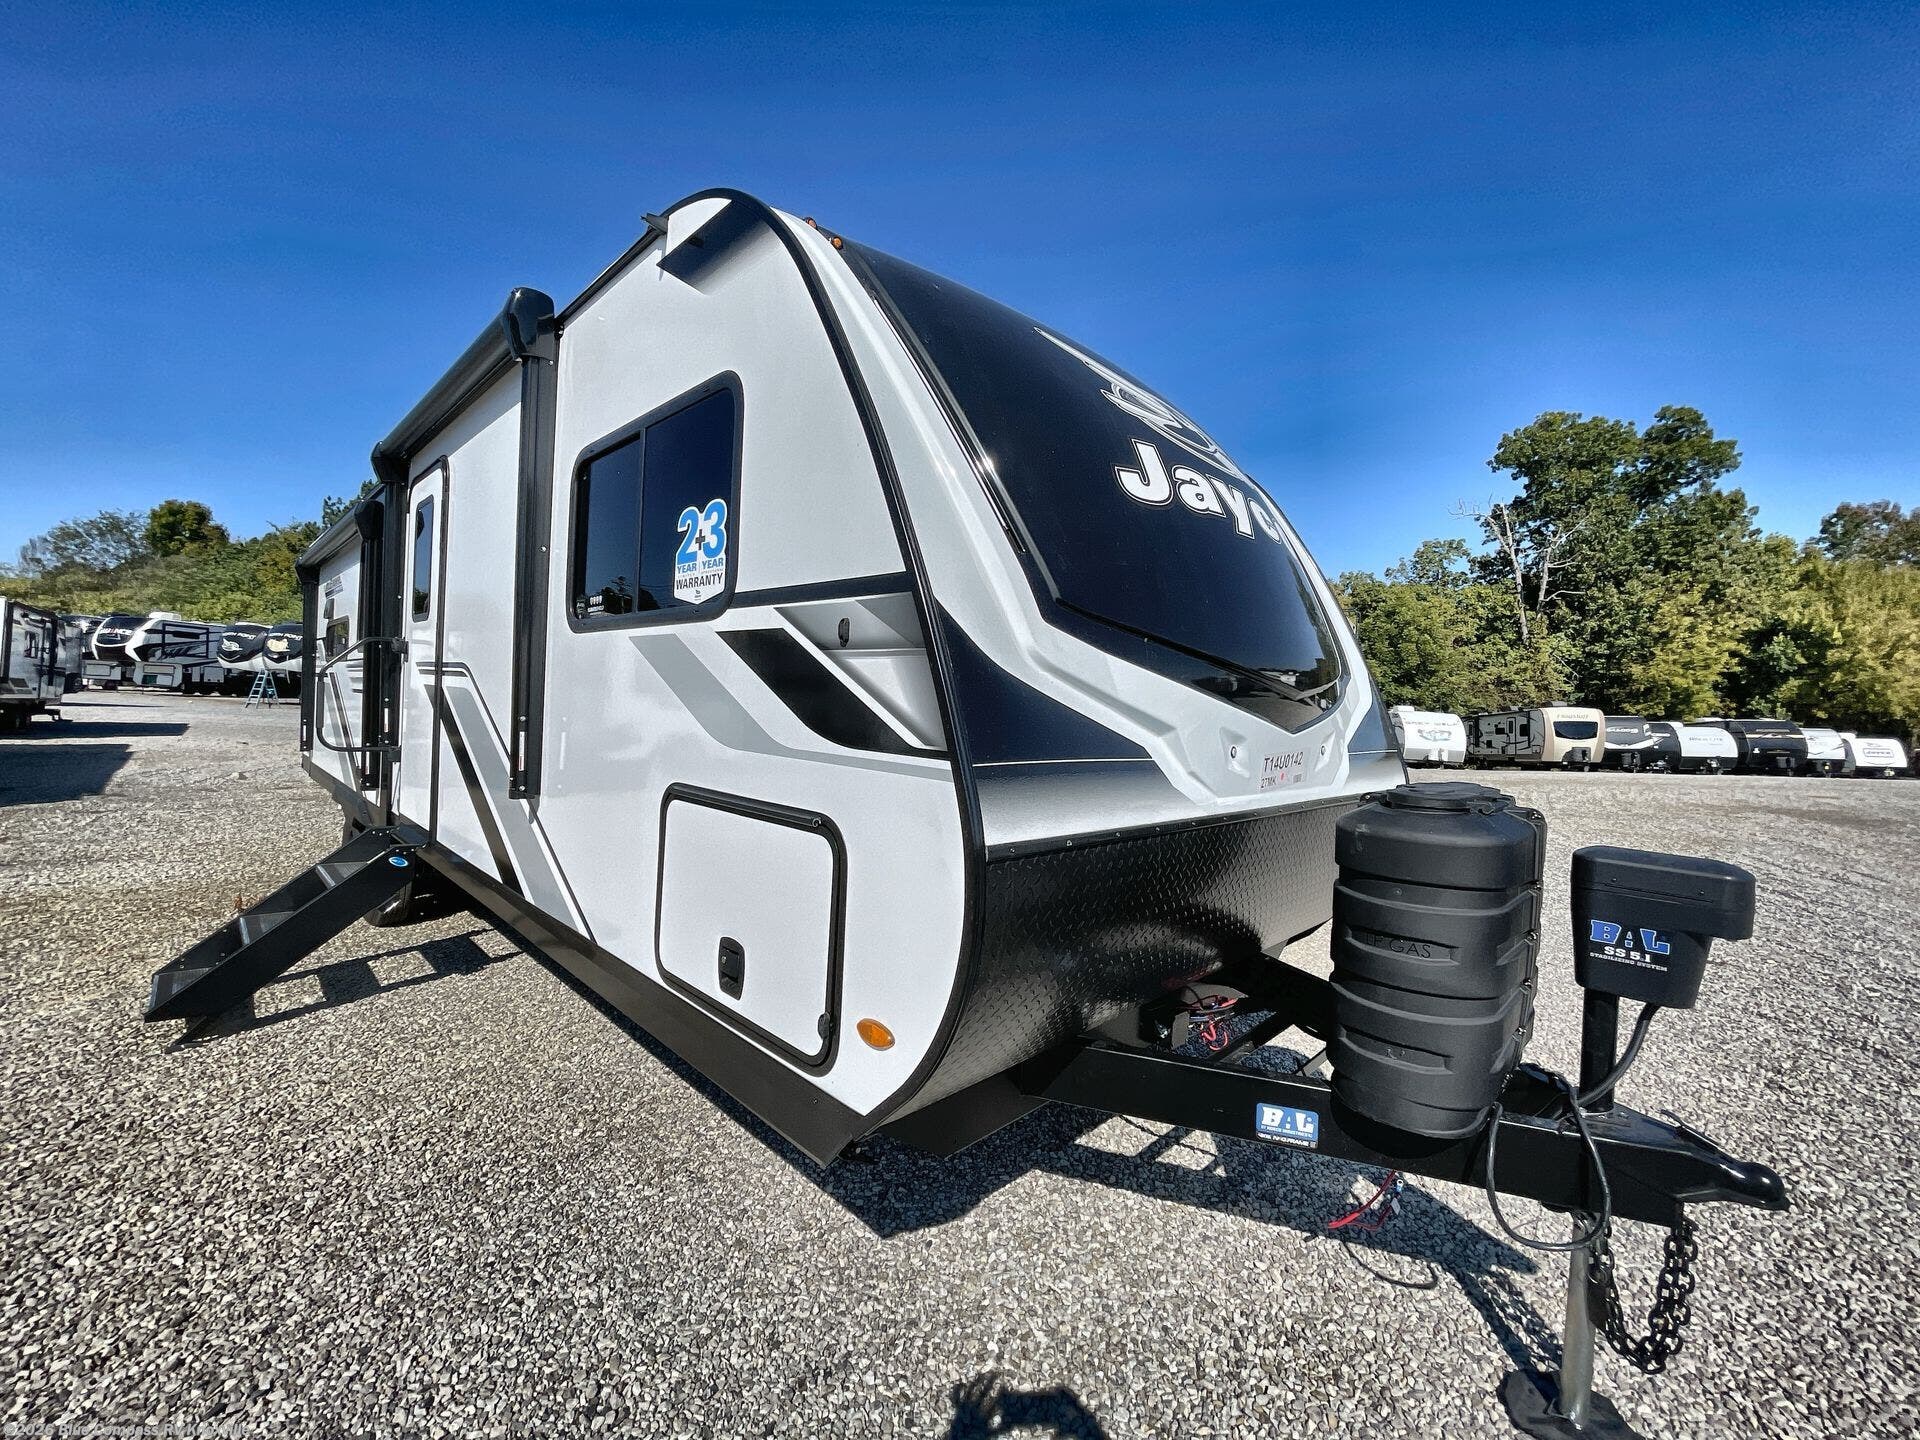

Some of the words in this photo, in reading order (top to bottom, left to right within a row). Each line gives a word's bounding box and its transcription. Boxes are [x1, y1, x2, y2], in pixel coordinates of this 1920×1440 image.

[677, 563, 697, 574] YEAR
[702, 557, 724, 570] YEAR
[676, 573, 723, 590] WARRANTY
[1264, 751, 1304, 772] T14U0142
[1389, 938, 1431, 958] GAS
[1604, 946, 1626, 957] SS
[1630, 951, 1651, 963] 5.1
[1590, 953, 1635, 965] STABILIZING
[1637, 961, 1667, 971] SYSTEM
